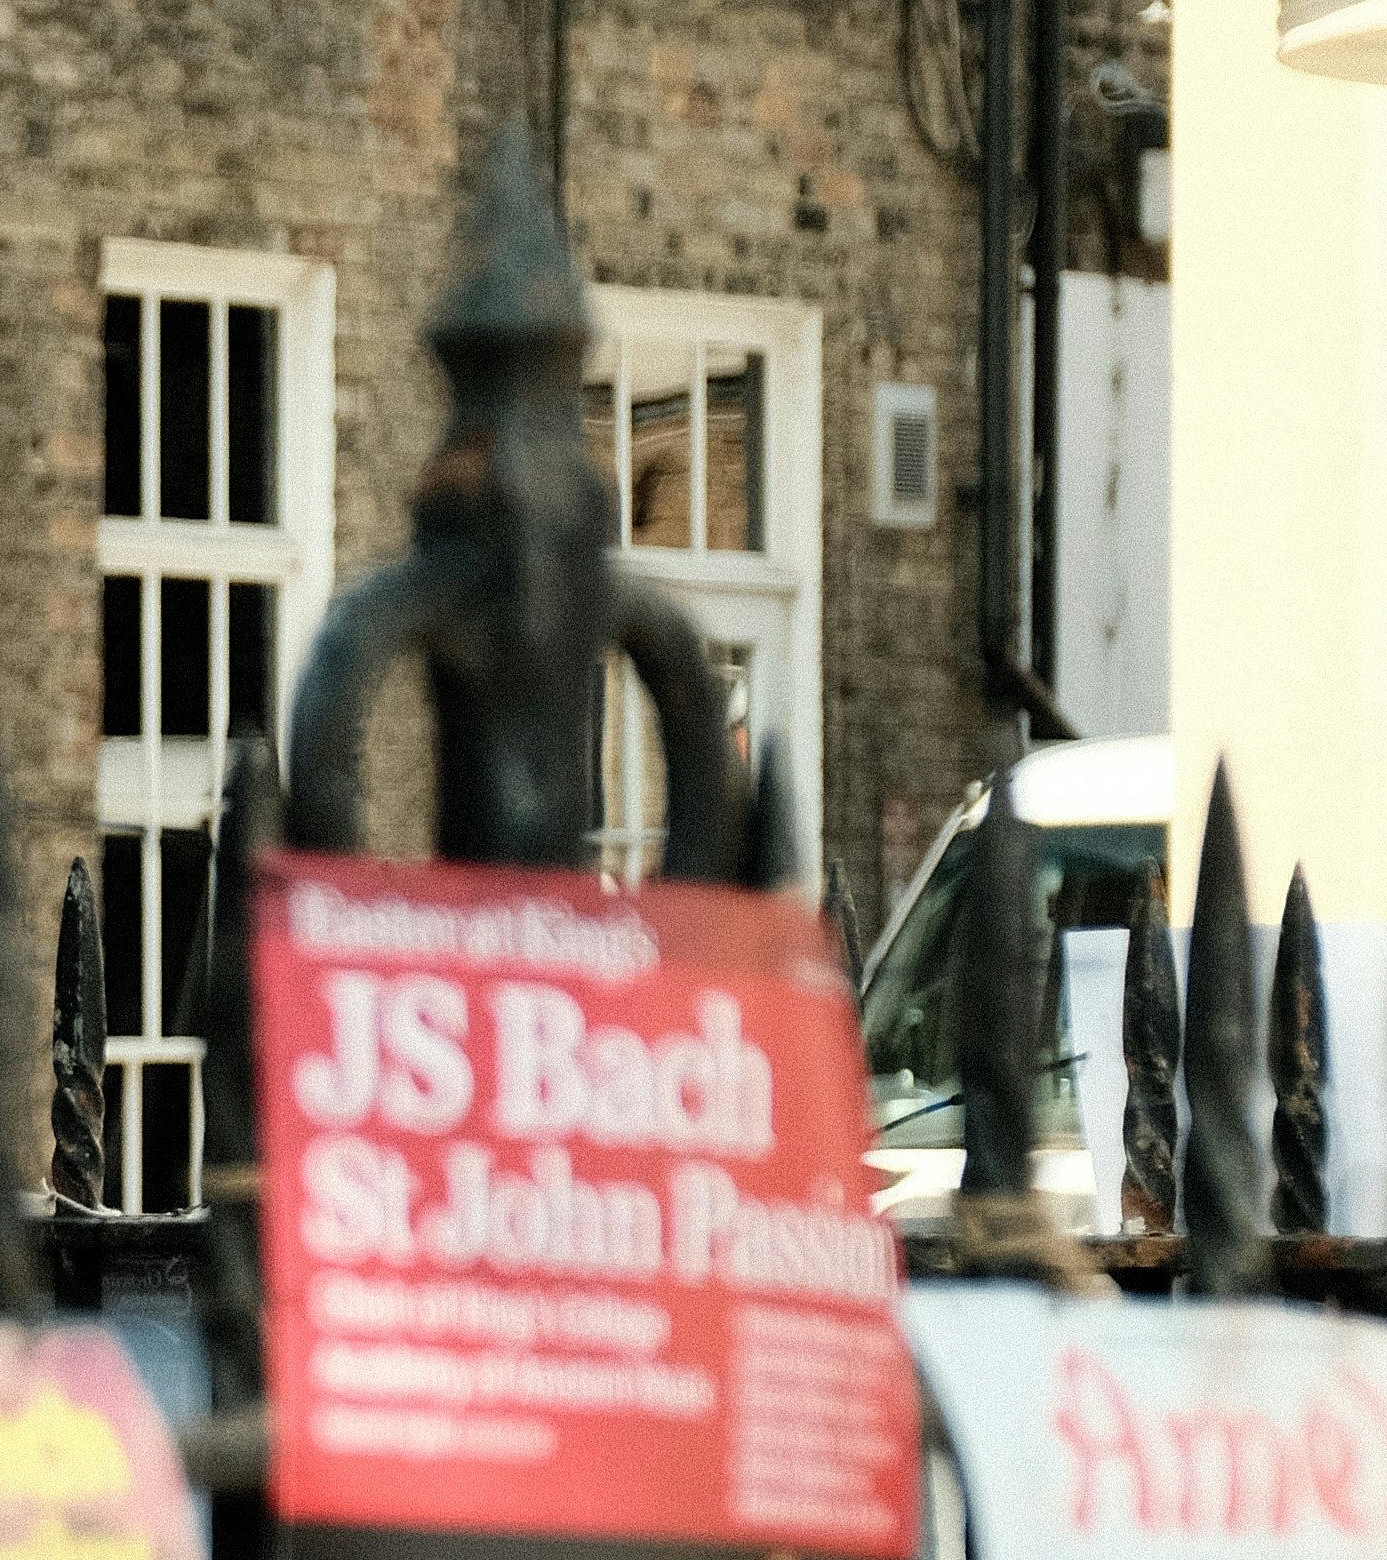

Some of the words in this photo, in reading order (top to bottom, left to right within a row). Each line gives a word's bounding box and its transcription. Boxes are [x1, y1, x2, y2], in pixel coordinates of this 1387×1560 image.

[297, 974, 473, 1130] JS
[493, 985, 774, 1154] Bach
[303, 1137, 415, 1262] St
[421, 1144, 663, 1278] John
